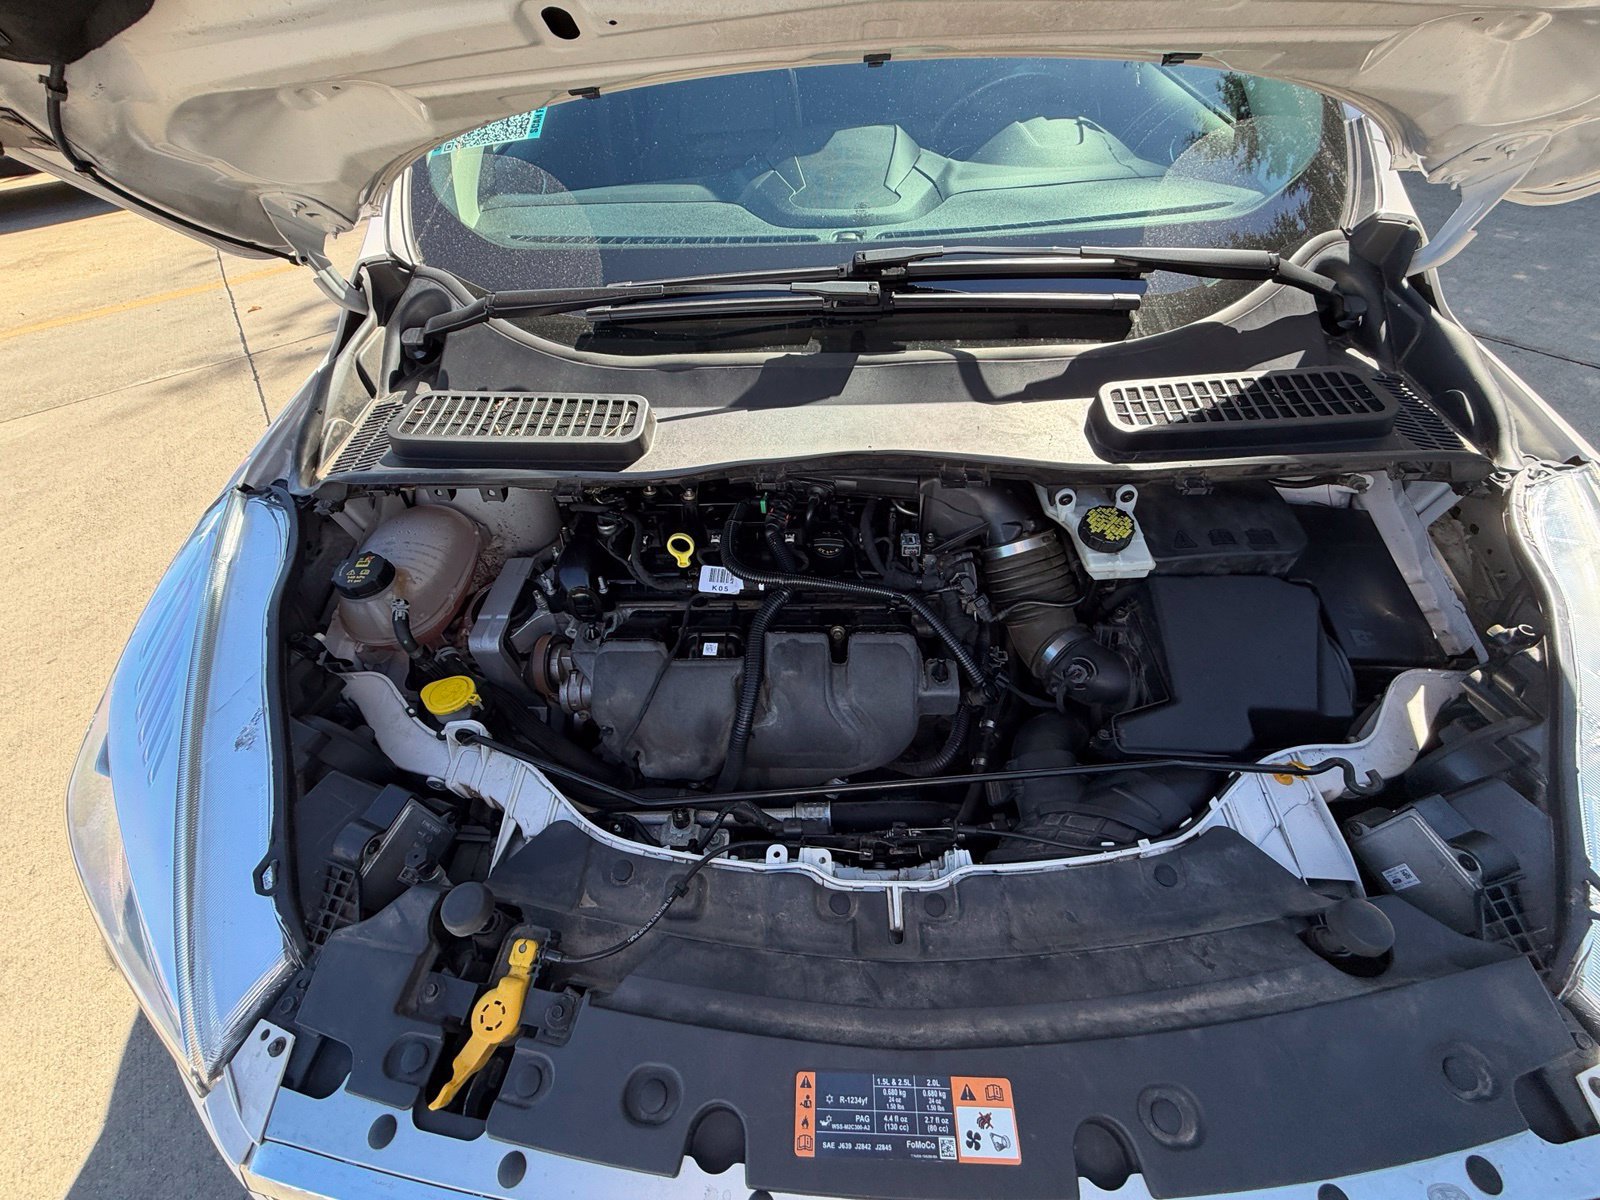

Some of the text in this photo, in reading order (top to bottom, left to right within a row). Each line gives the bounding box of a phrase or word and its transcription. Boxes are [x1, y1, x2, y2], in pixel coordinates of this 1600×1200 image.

[530, 114, 542, 133] SCAN
[876, 1078, 912, 1087] 1.5L & 2.5L
[926, 1079, 940, 1087] 2.0L
[899, 1089, 907, 1098] kg
[939, 1090, 946, 1099] kg
[839, 1095, 868, 1106] R-1234yf
[855, 1114, 870, 1122] PAG
[883, 1114, 893, 1122] 4.4
[924, 1116, 934, 1124] 2.7
[935, 1116, 940, 1124] fl
[884, 1123, 909, 1133] (130 cc)
[927, 1125, 949, 1134] (80 cc)
[822, 1141, 836, 1149] SAE
[906, 1140, 936, 1149] FoMoCo
